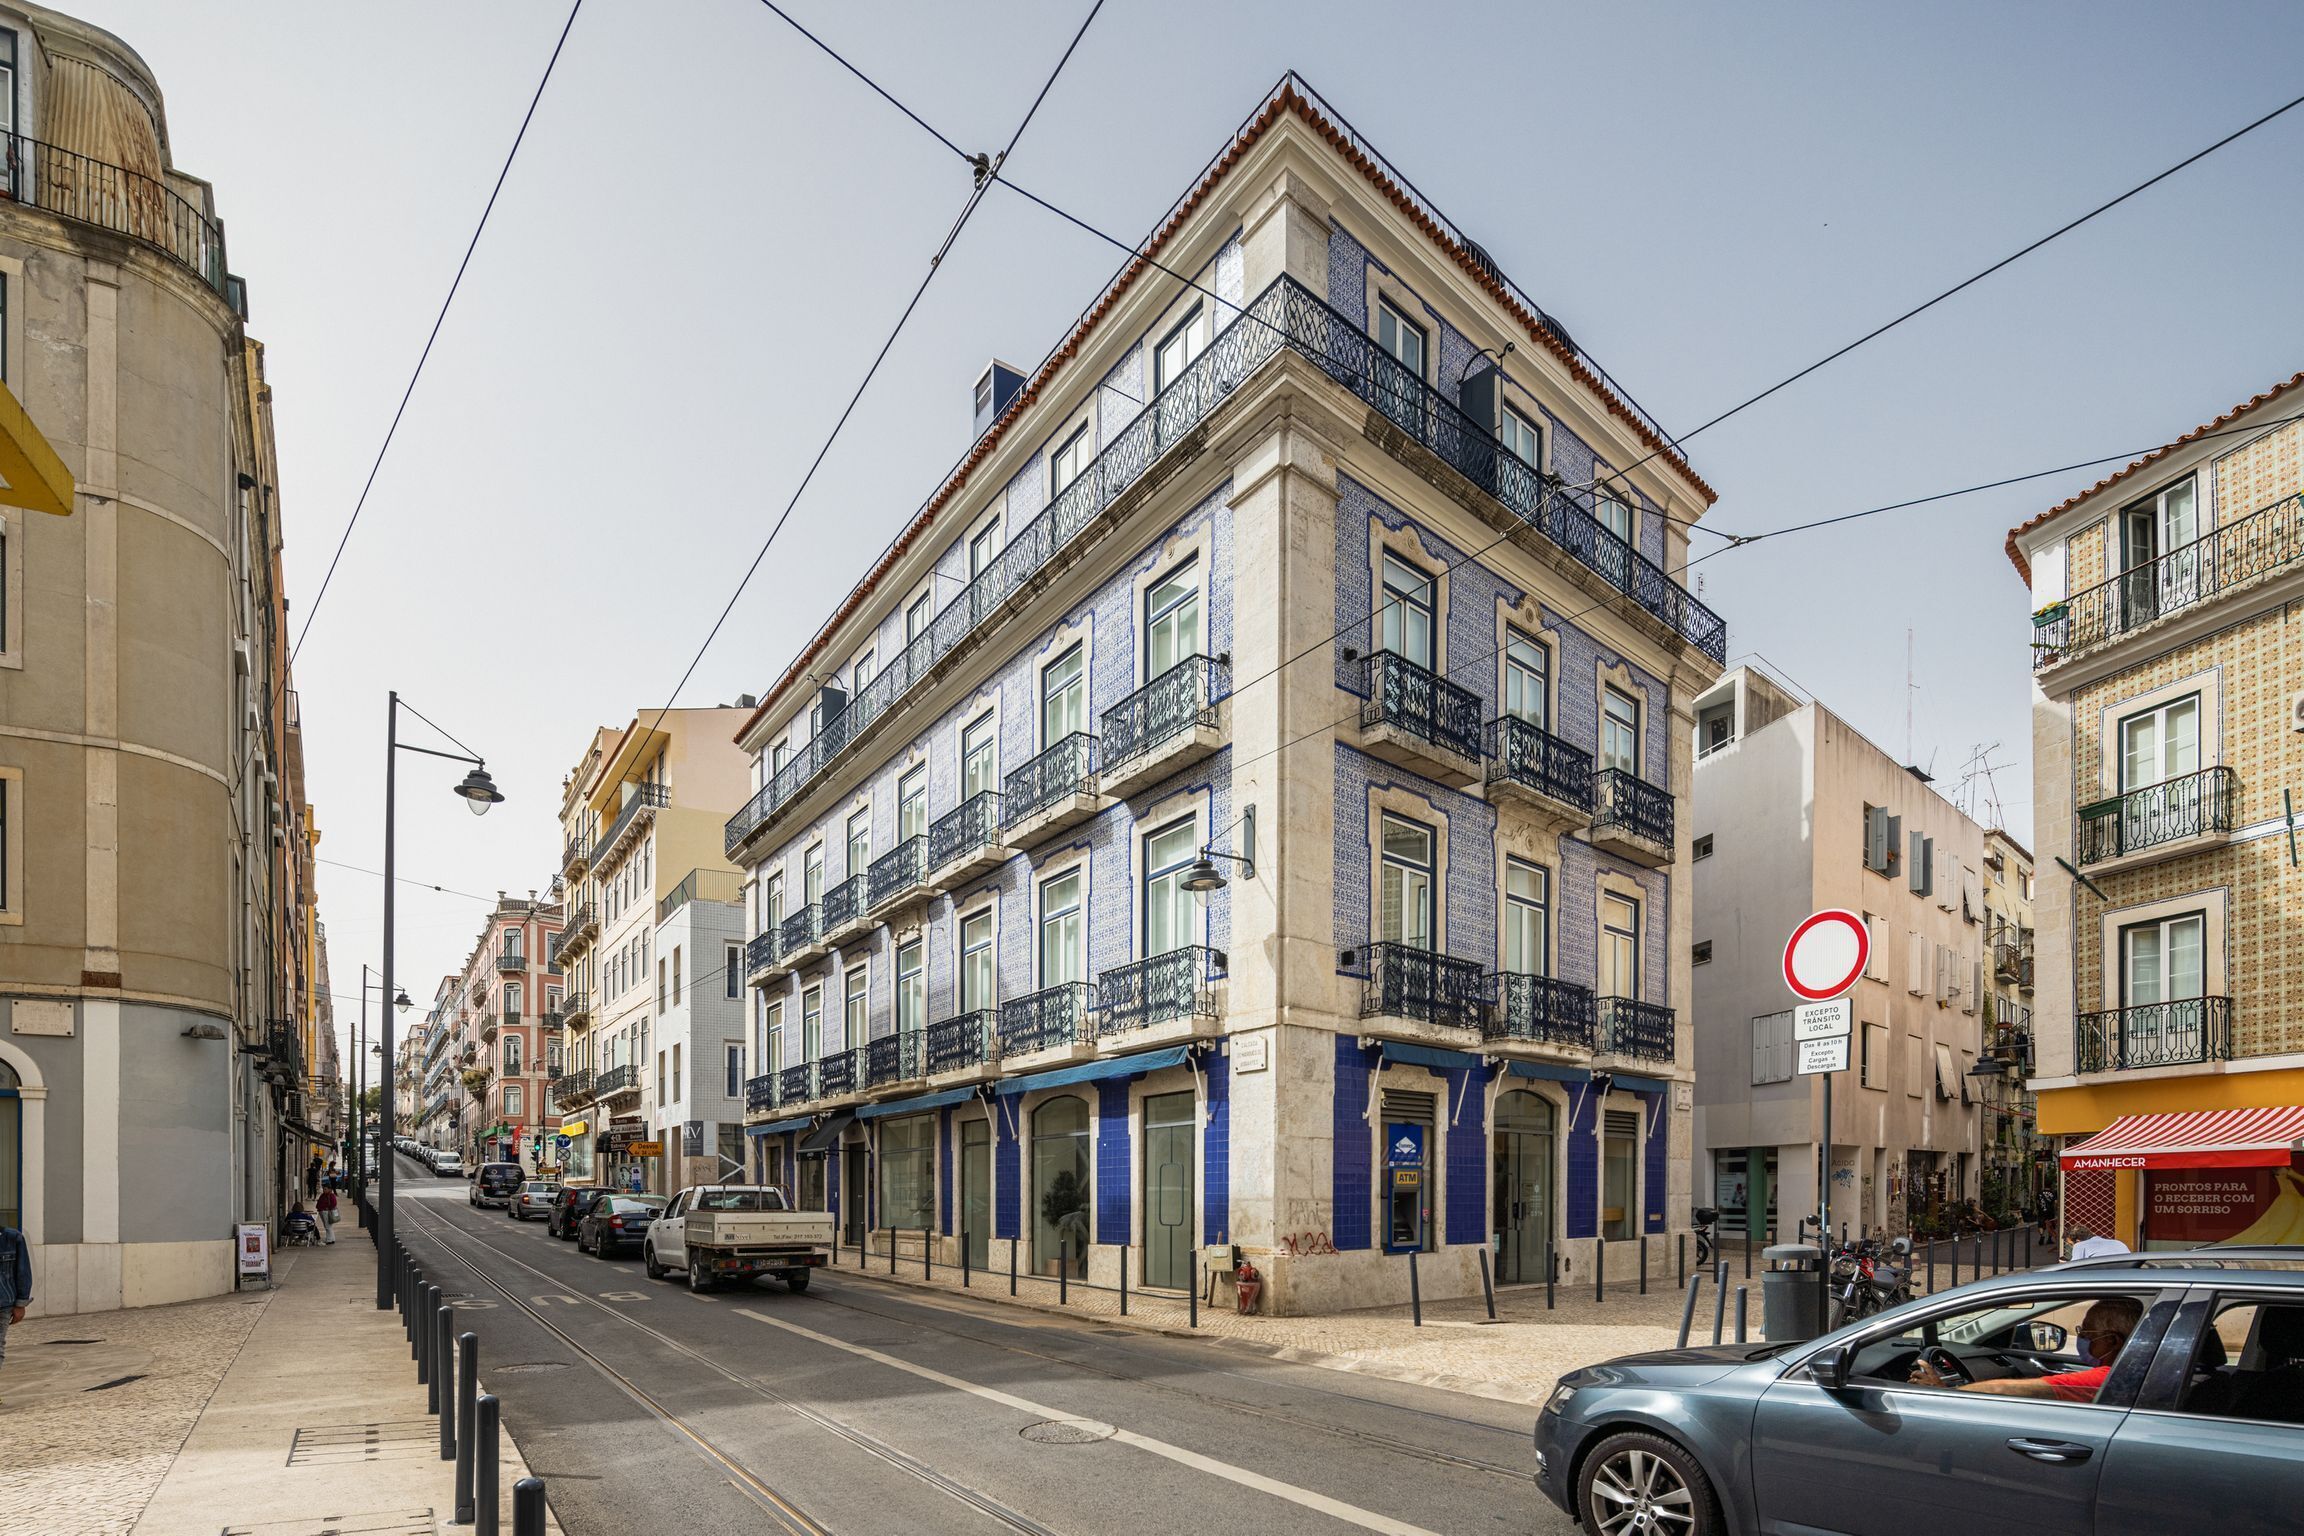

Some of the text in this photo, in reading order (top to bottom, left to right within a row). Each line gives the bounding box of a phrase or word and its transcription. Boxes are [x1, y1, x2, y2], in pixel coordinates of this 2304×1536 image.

[1805, 1007, 1838, 1017] EXCEPTO
[1809, 1023, 1833, 1032] LOCAL
[2073, 1157, 2146, 1169] AMANHECER
[1399, 1173, 1417, 1182] ATM
[2154, 1182, 2248, 1191] PRONTOS PARA
[2154, 1194, 2255, 1203] O RECEBER COM
[2154, 1205, 2231, 1214] UM SORRISO
[451, 1291, 653, 1310] BUS
